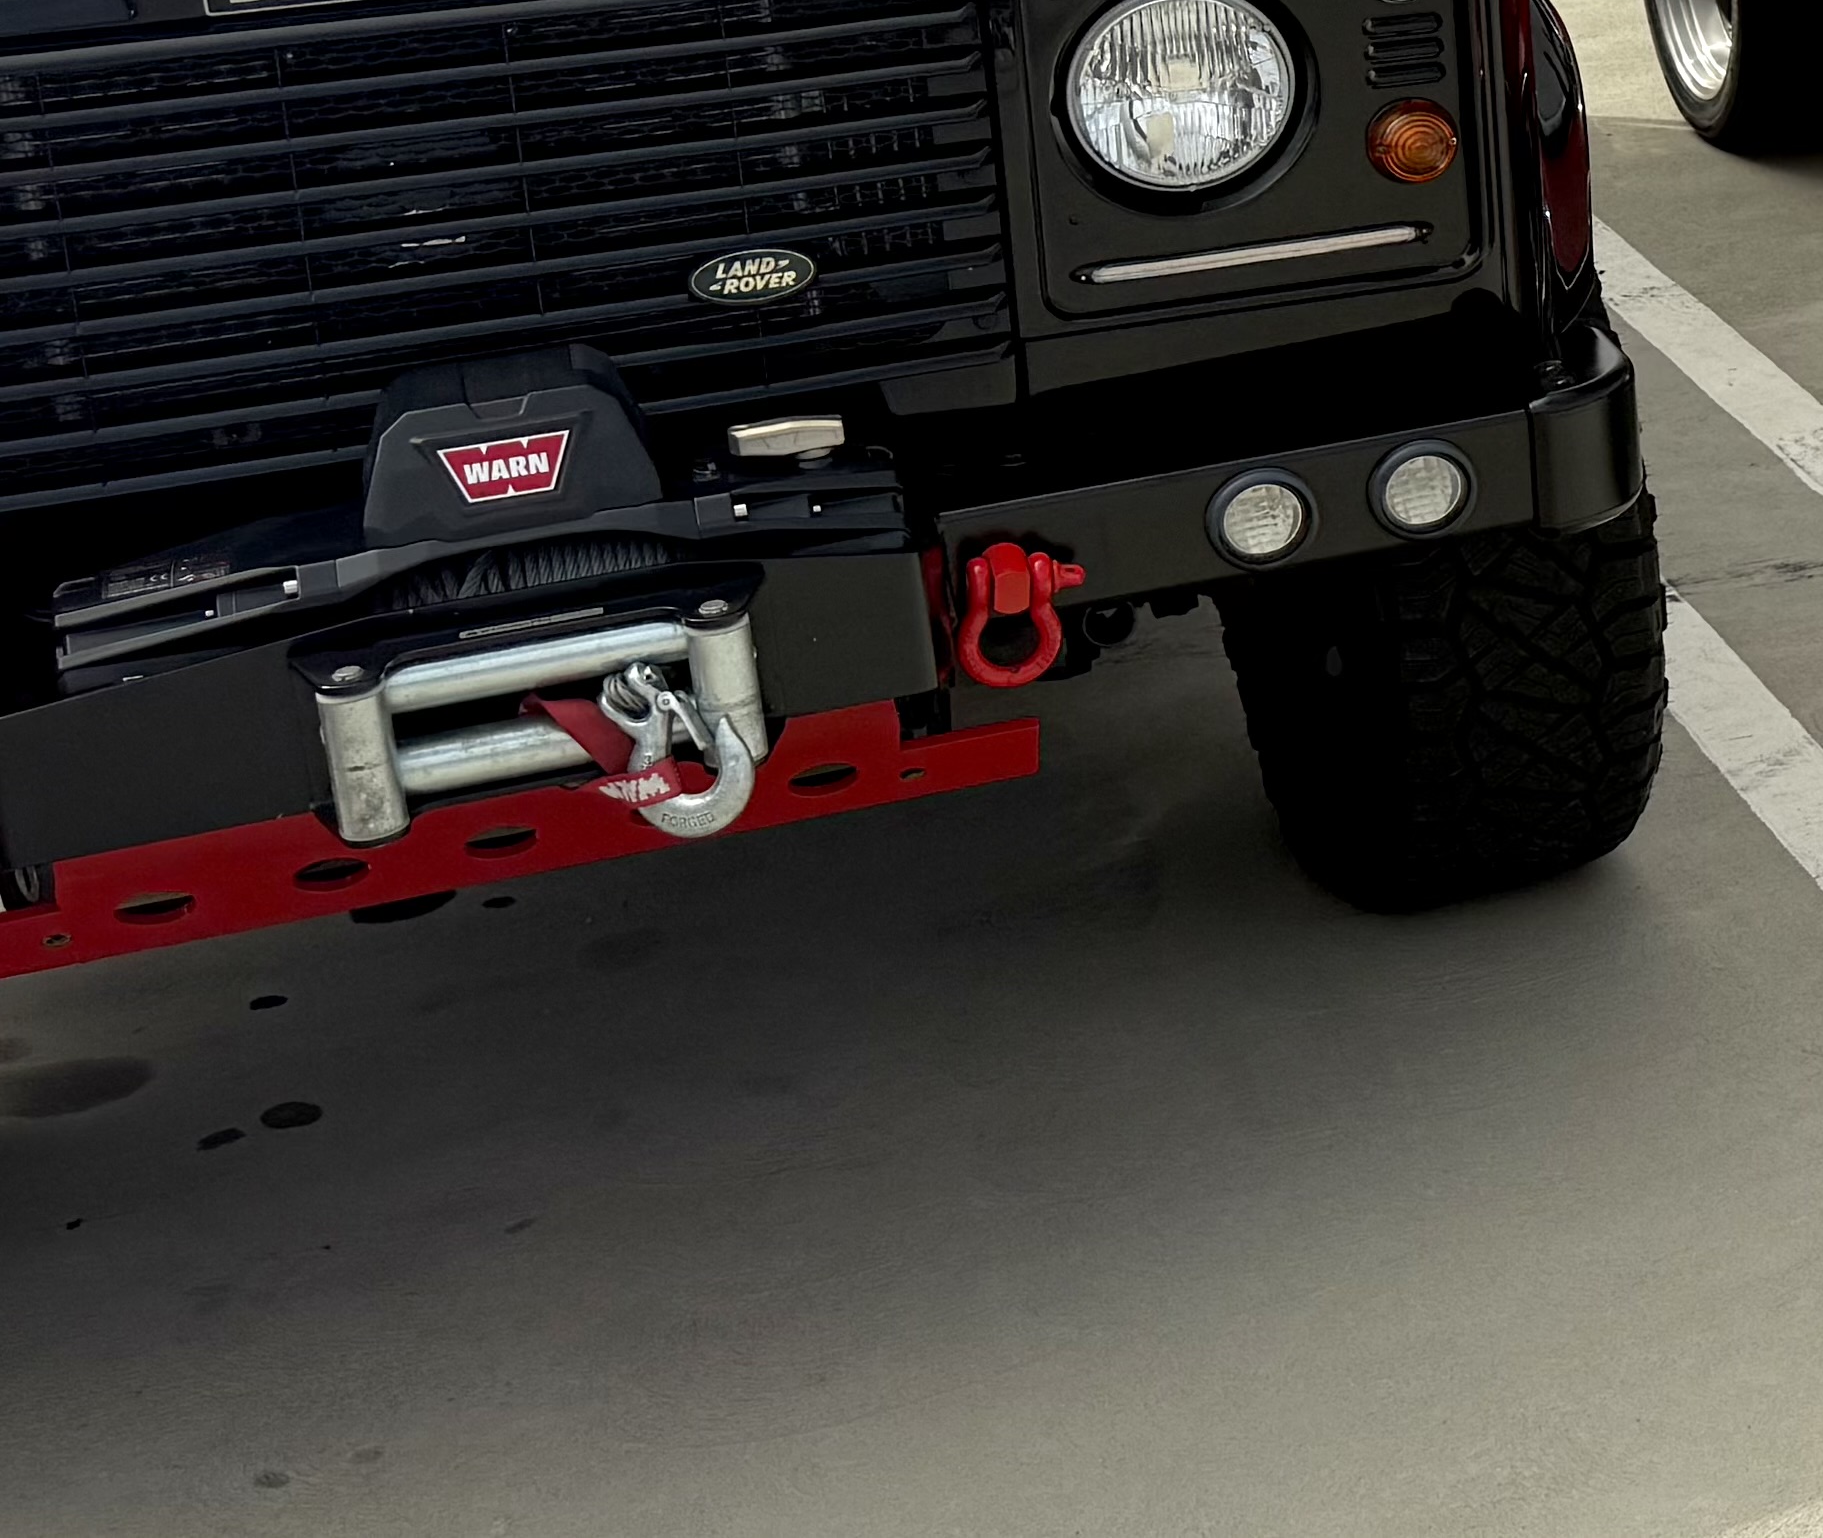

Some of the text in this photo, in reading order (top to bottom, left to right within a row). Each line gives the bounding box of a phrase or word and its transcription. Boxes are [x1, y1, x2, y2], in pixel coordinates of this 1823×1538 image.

[715, 257, 775, 279] LAND
[723, 271, 797, 295] ROVER
[463, 452, 550, 485] WARN
[661, 812, 715, 828] FORGED
